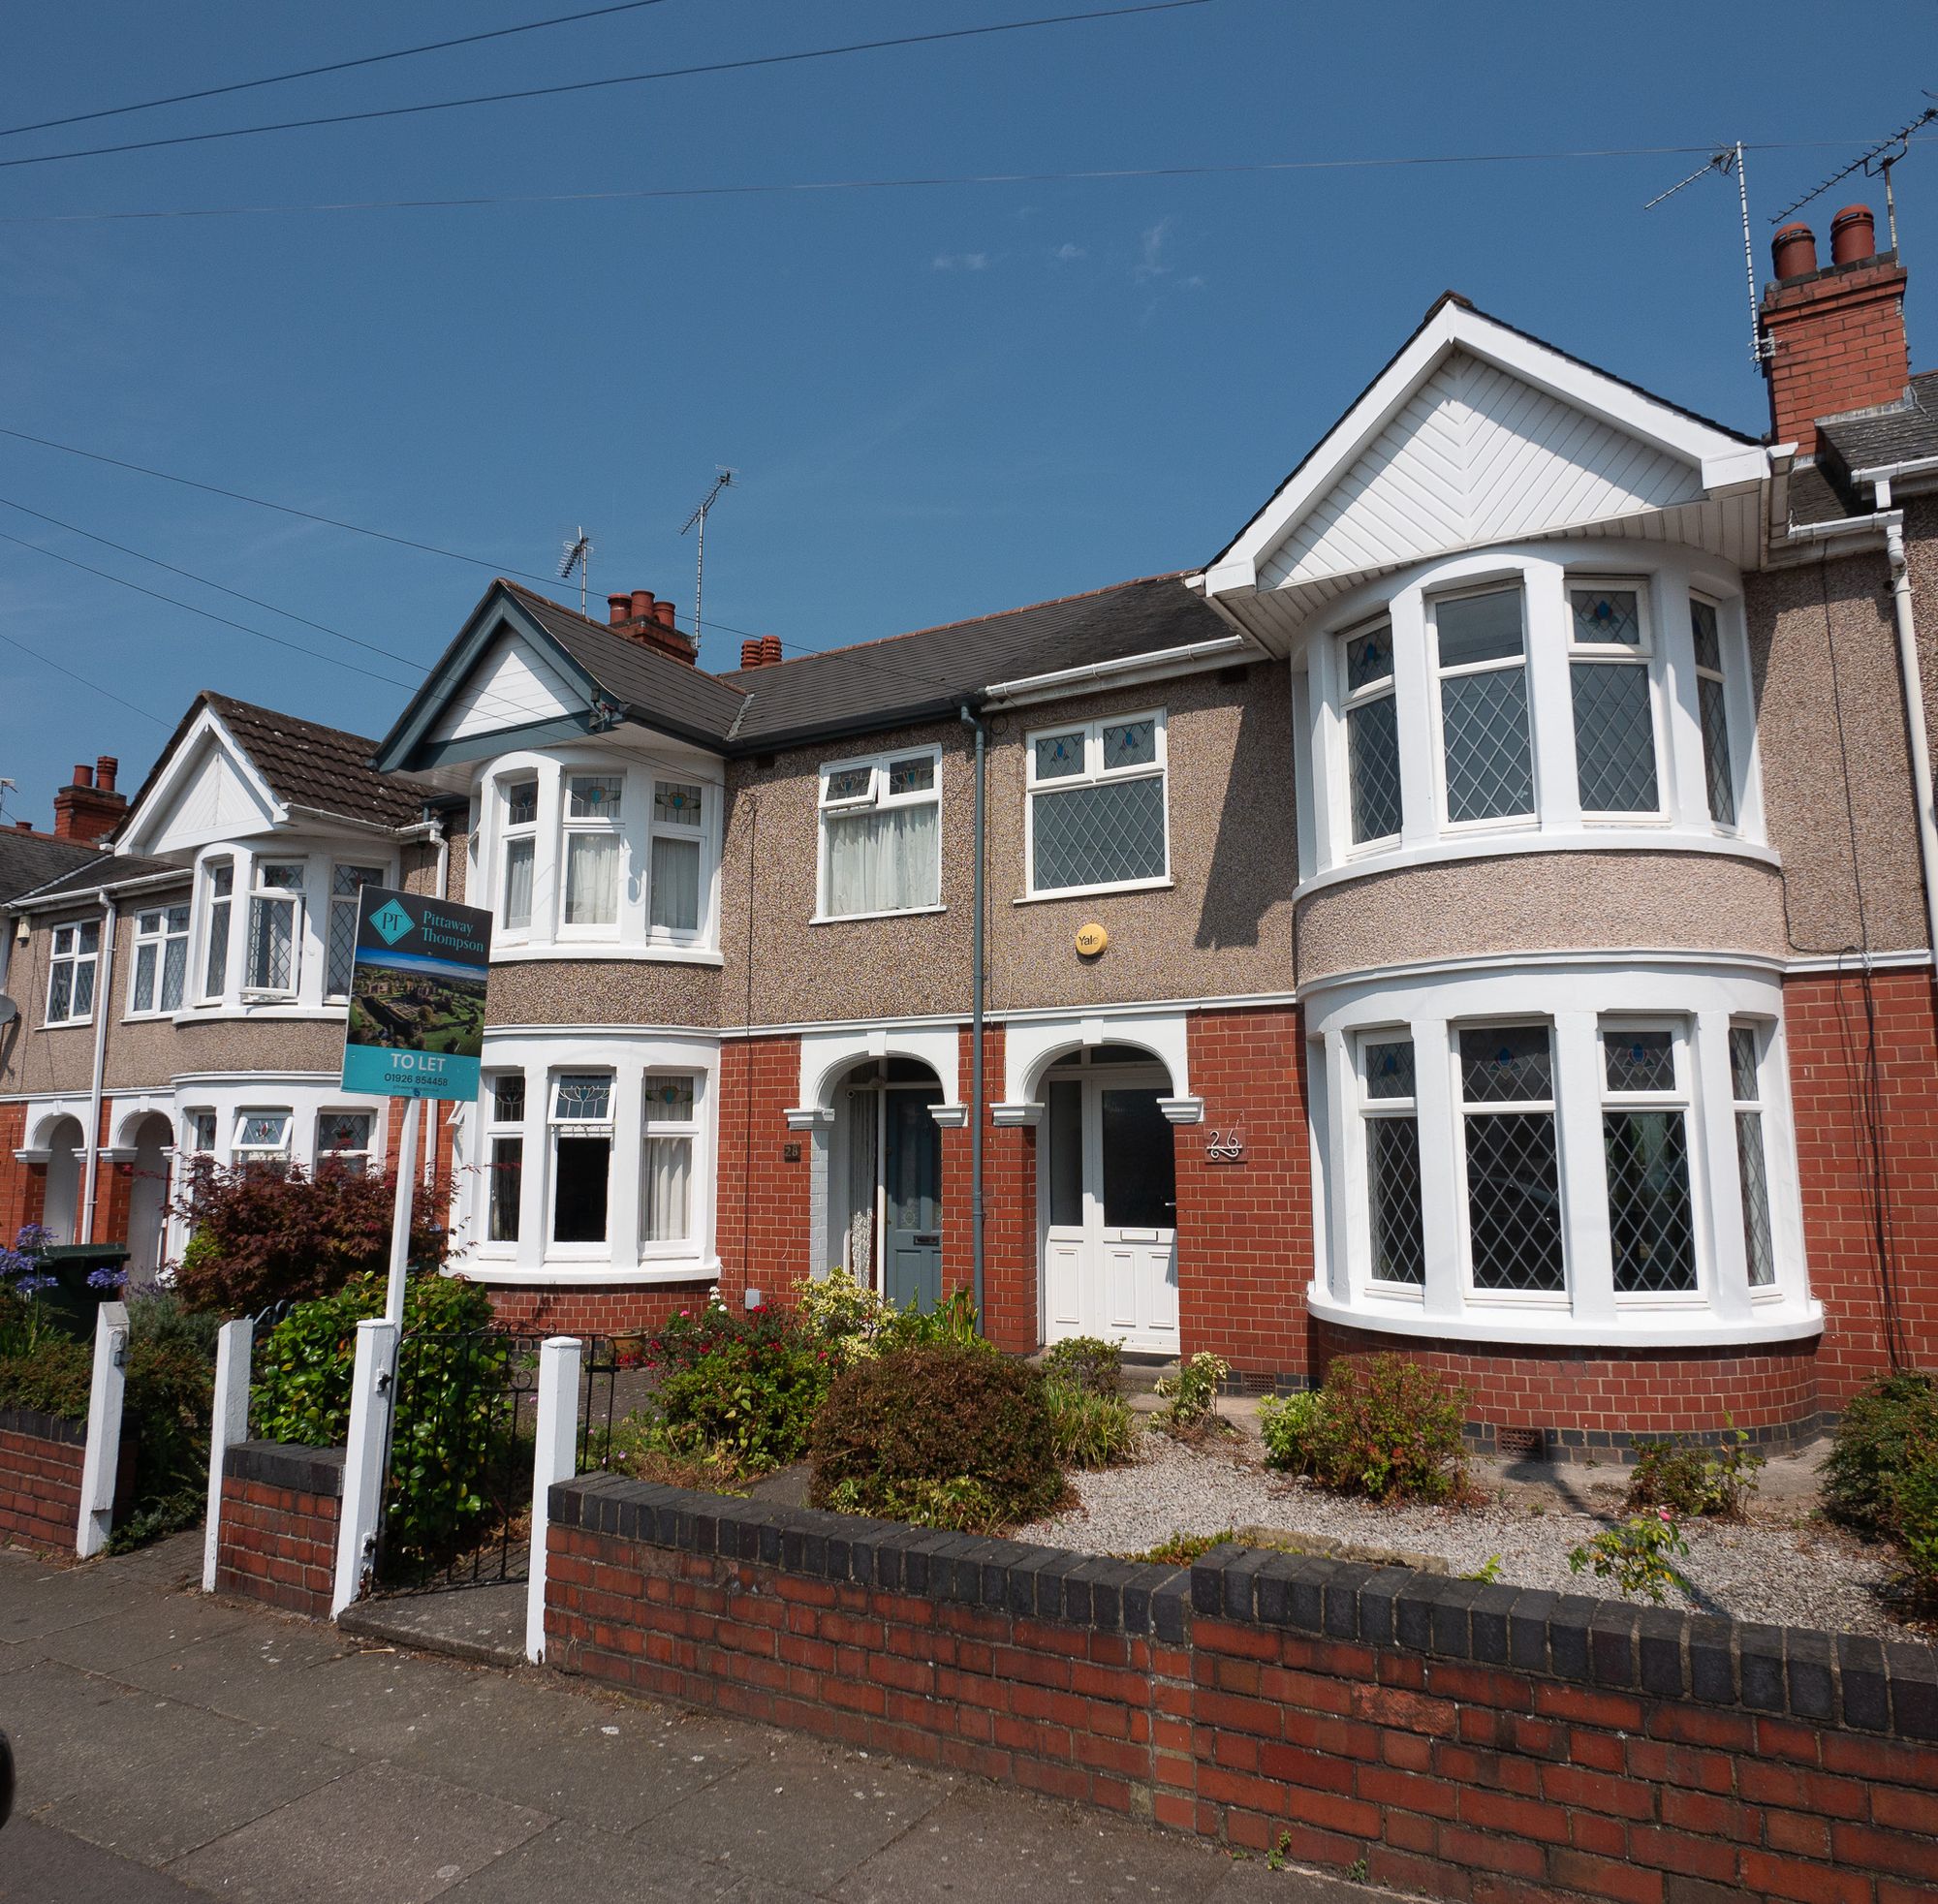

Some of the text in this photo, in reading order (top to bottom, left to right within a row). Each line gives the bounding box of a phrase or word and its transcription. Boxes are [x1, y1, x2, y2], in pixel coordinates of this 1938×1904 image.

[382, 912, 403, 931] PT
[423, 911, 474, 936] Pittaway
[422, 927, 484, 952] Thompson
[1078, 935, 1100, 946] Yale
[391, 1053, 446, 1072] TO LET
[384, 1073, 449, 1086] 01926 854458
[1209, 1128, 1239, 1149] 26
[785, 1144, 798, 1157] 28
